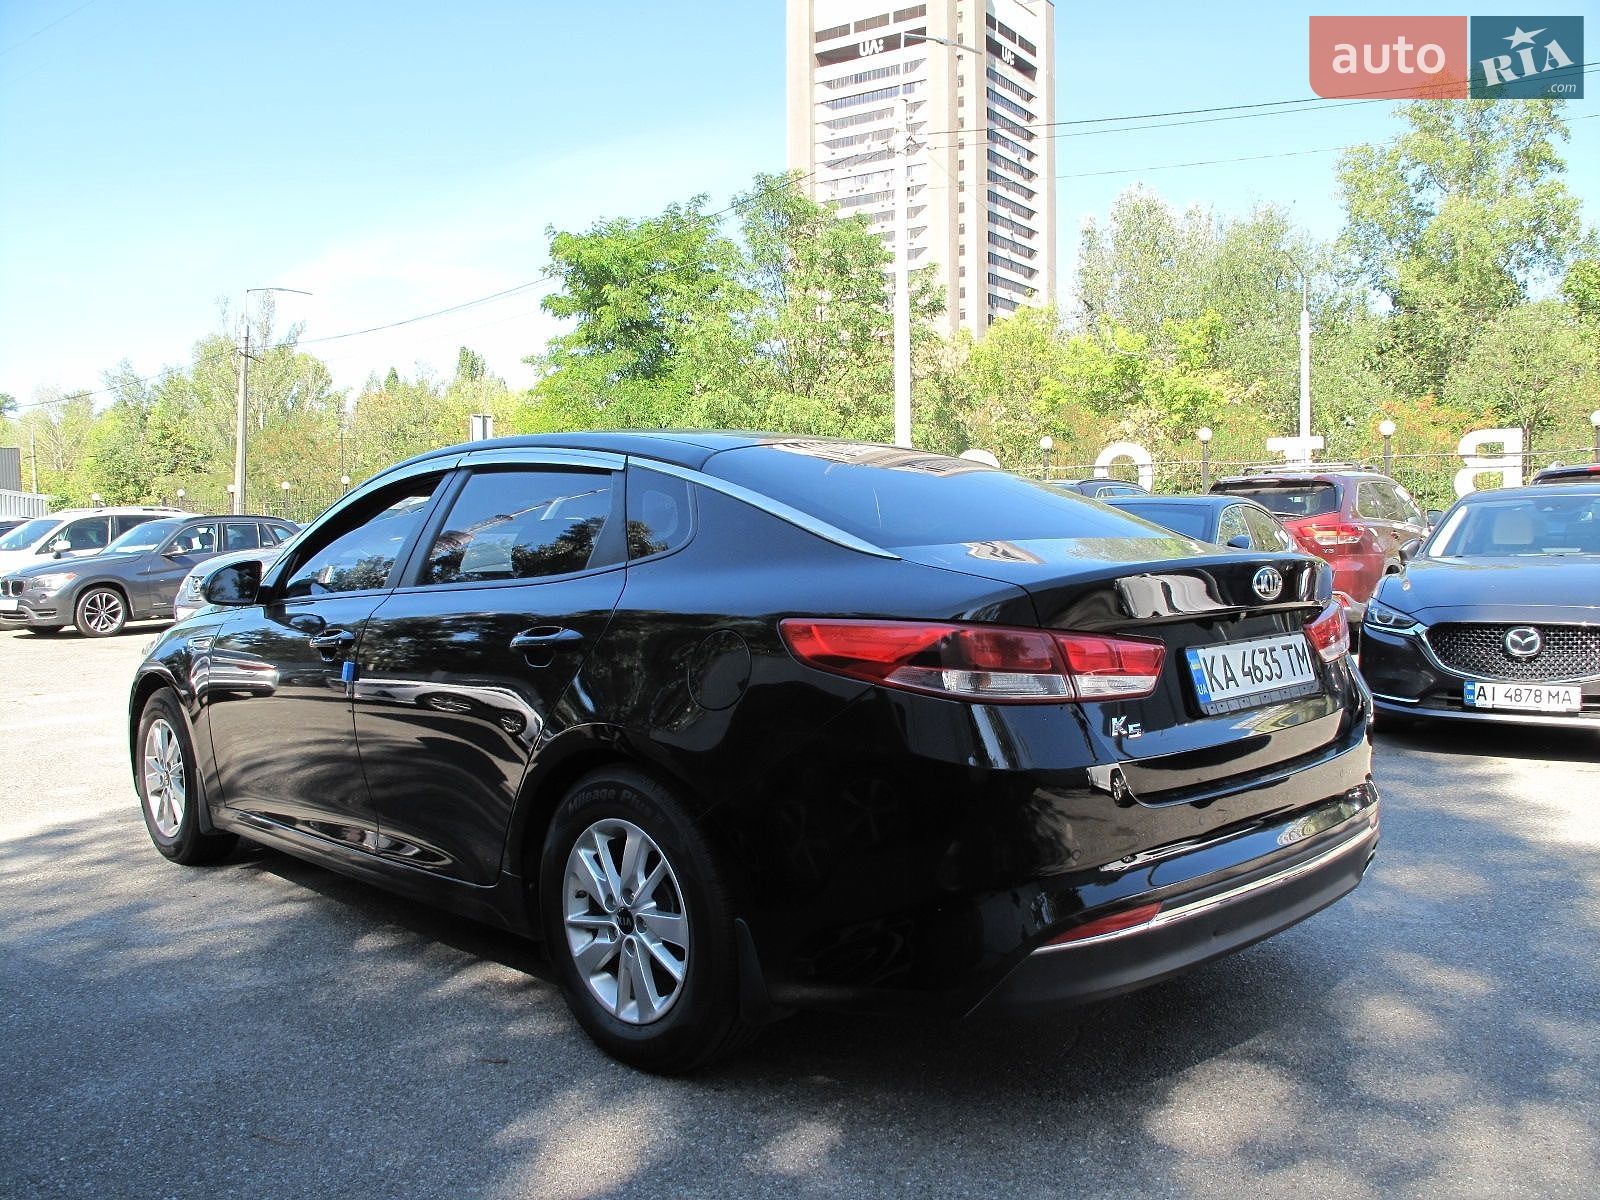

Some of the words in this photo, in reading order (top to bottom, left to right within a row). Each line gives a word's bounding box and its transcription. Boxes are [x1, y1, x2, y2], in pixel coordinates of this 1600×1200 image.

[1202, 654, 1239, 692] KA
[1241, 646, 1283, 685] 4635
[1281, 643, 1311, 677] TM
[1197, 684, 1208, 695] UA
[1476, 685, 1495, 702] AI
[1504, 687, 1543, 703] 4878
[1547, 689, 1572, 705] MA
[1110, 715, 1145, 739] K5
